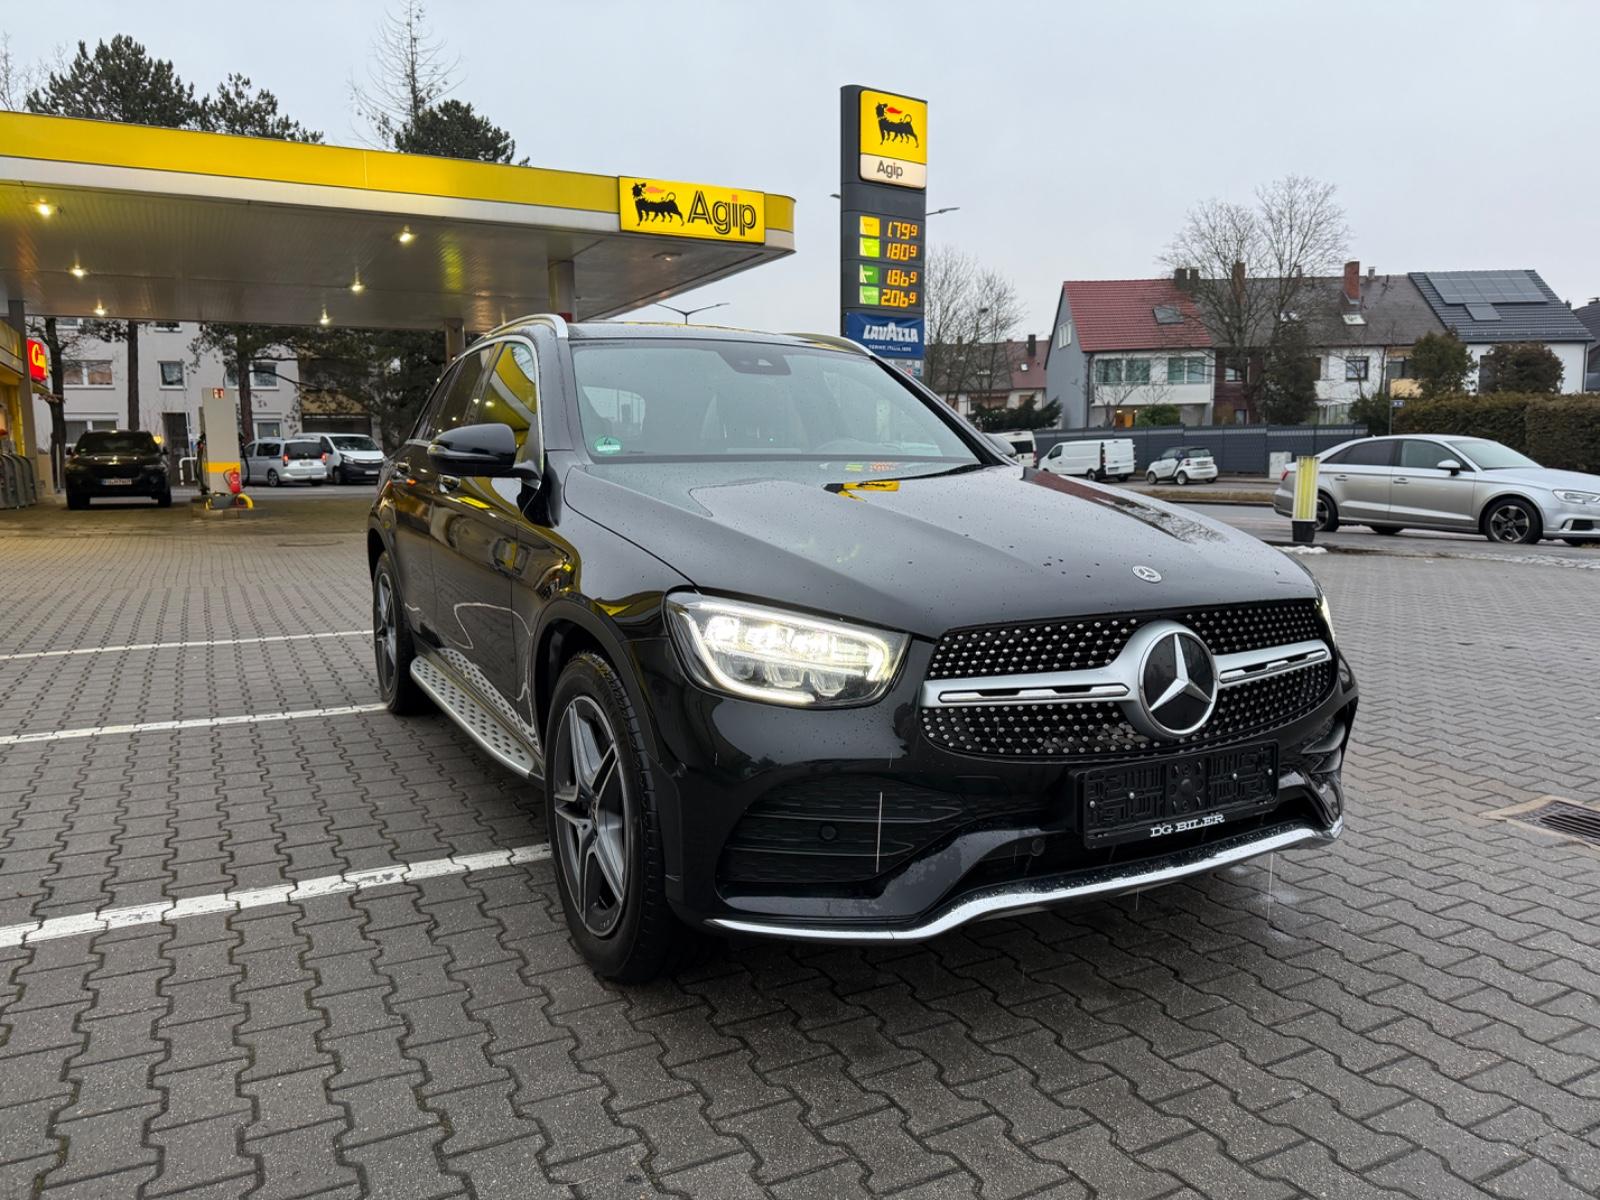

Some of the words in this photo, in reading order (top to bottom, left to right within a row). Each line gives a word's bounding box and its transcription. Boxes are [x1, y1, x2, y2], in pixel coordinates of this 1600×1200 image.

[876, 160, 904, 179] Agip
[687, 190, 756, 236] Agip
[863, 321, 919, 343] LAVAZZA
[1150, 825, 1173, 837] DG
[1175, 814, 1225, 832] BILER
